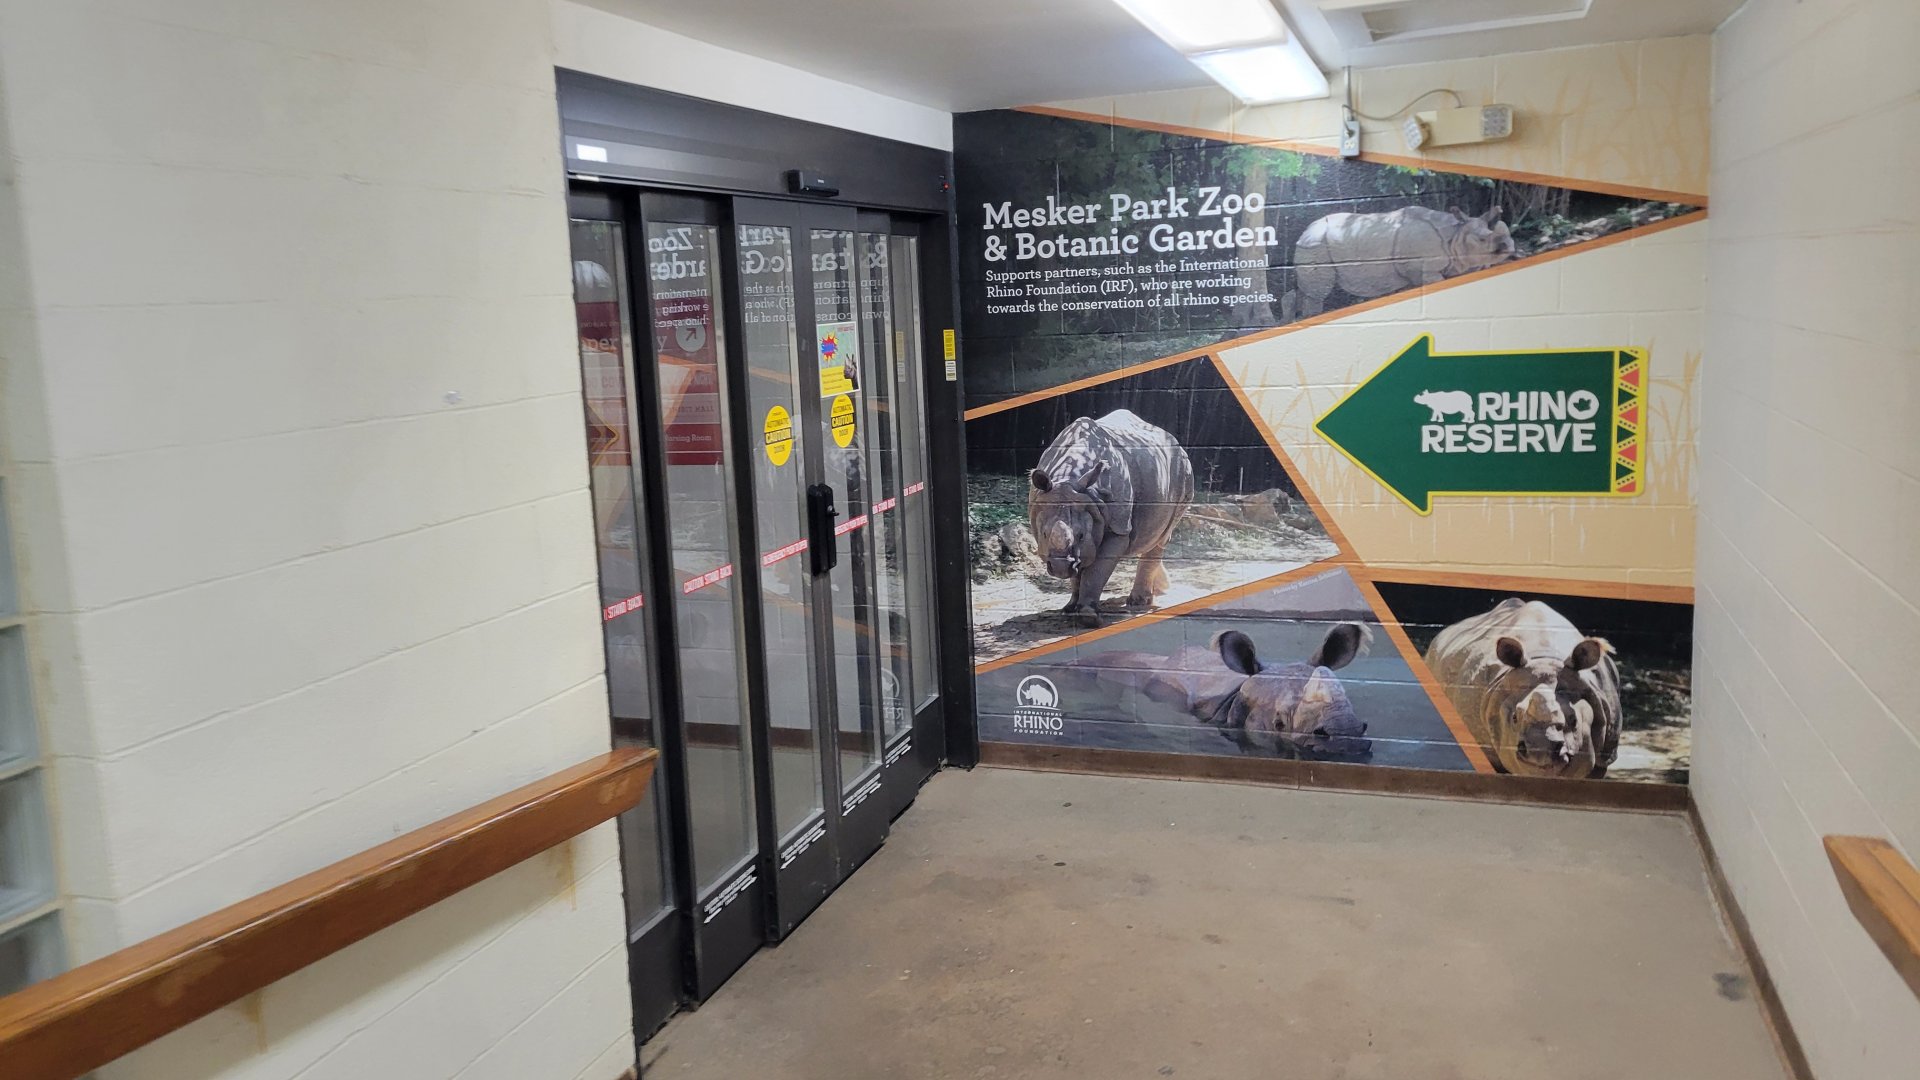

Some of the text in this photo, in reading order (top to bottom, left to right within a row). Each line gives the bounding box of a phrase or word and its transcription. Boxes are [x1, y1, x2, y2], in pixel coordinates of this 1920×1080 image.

[983, 186, 1265, 229] Mesker Park Zoo
[984, 217, 1278, 261] & Botanic Garden
[986, 254, 1269, 283] Supports partners, such as the International
[986, 274, 1252, 298] Rhino Foundation (IRF), who are working
[987, 291, 1277, 314] towards the conservation of all rhino species.
[1478, 390, 1600, 422] RHINO
[832, 414, 854, 428] CAUTION
[766, 428, 791, 443] CAUTION
[1421, 422, 1597, 453] RESERVE
[1013, 715, 1063, 730] RHINO
